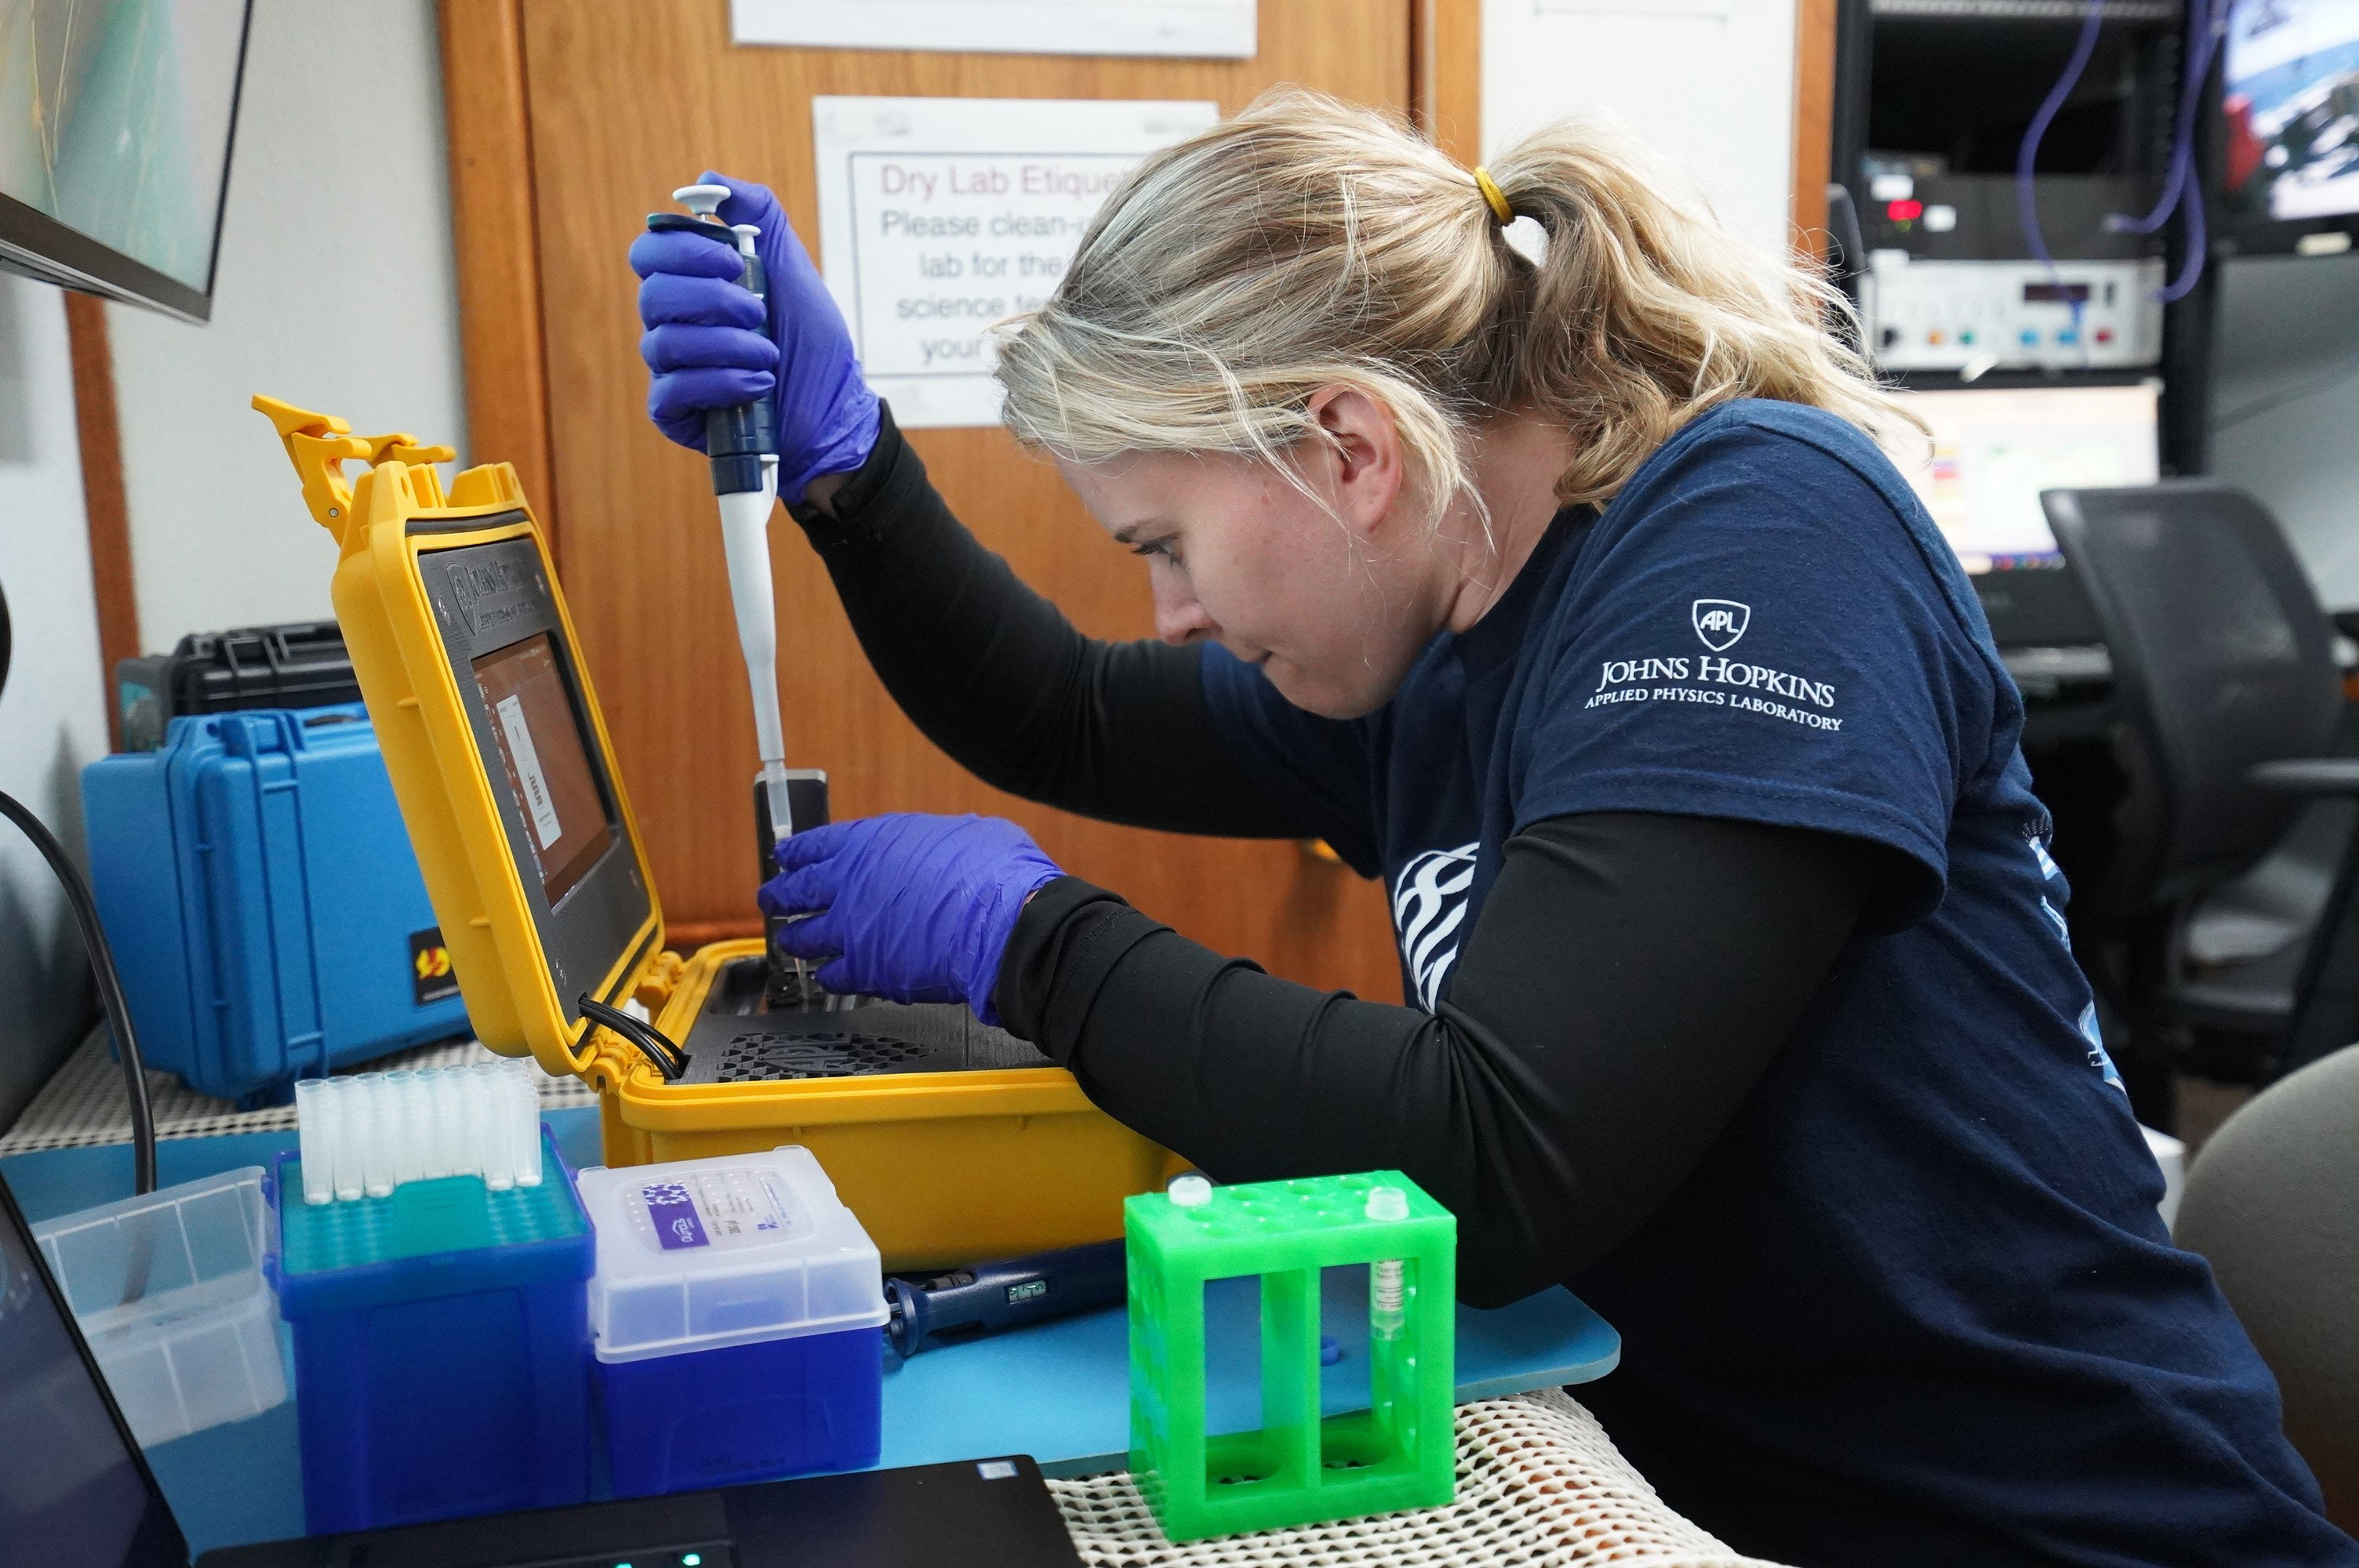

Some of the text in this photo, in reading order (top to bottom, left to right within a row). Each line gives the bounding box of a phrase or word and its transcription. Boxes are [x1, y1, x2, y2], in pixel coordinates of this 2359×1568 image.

[881, 164, 938, 201] Dry
[950, 165, 1009, 195] Lab
[880, 209, 980, 238] Please
[919, 251, 1063, 278] lab for the
[896, 292, 1005, 318] science
[1699, 610, 1740, 633] APL
[1595, 655, 1836, 708] JOHNS HOPKINS
[1584, 688, 1844, 731] APPLIED PHYSICS LABORATORY
